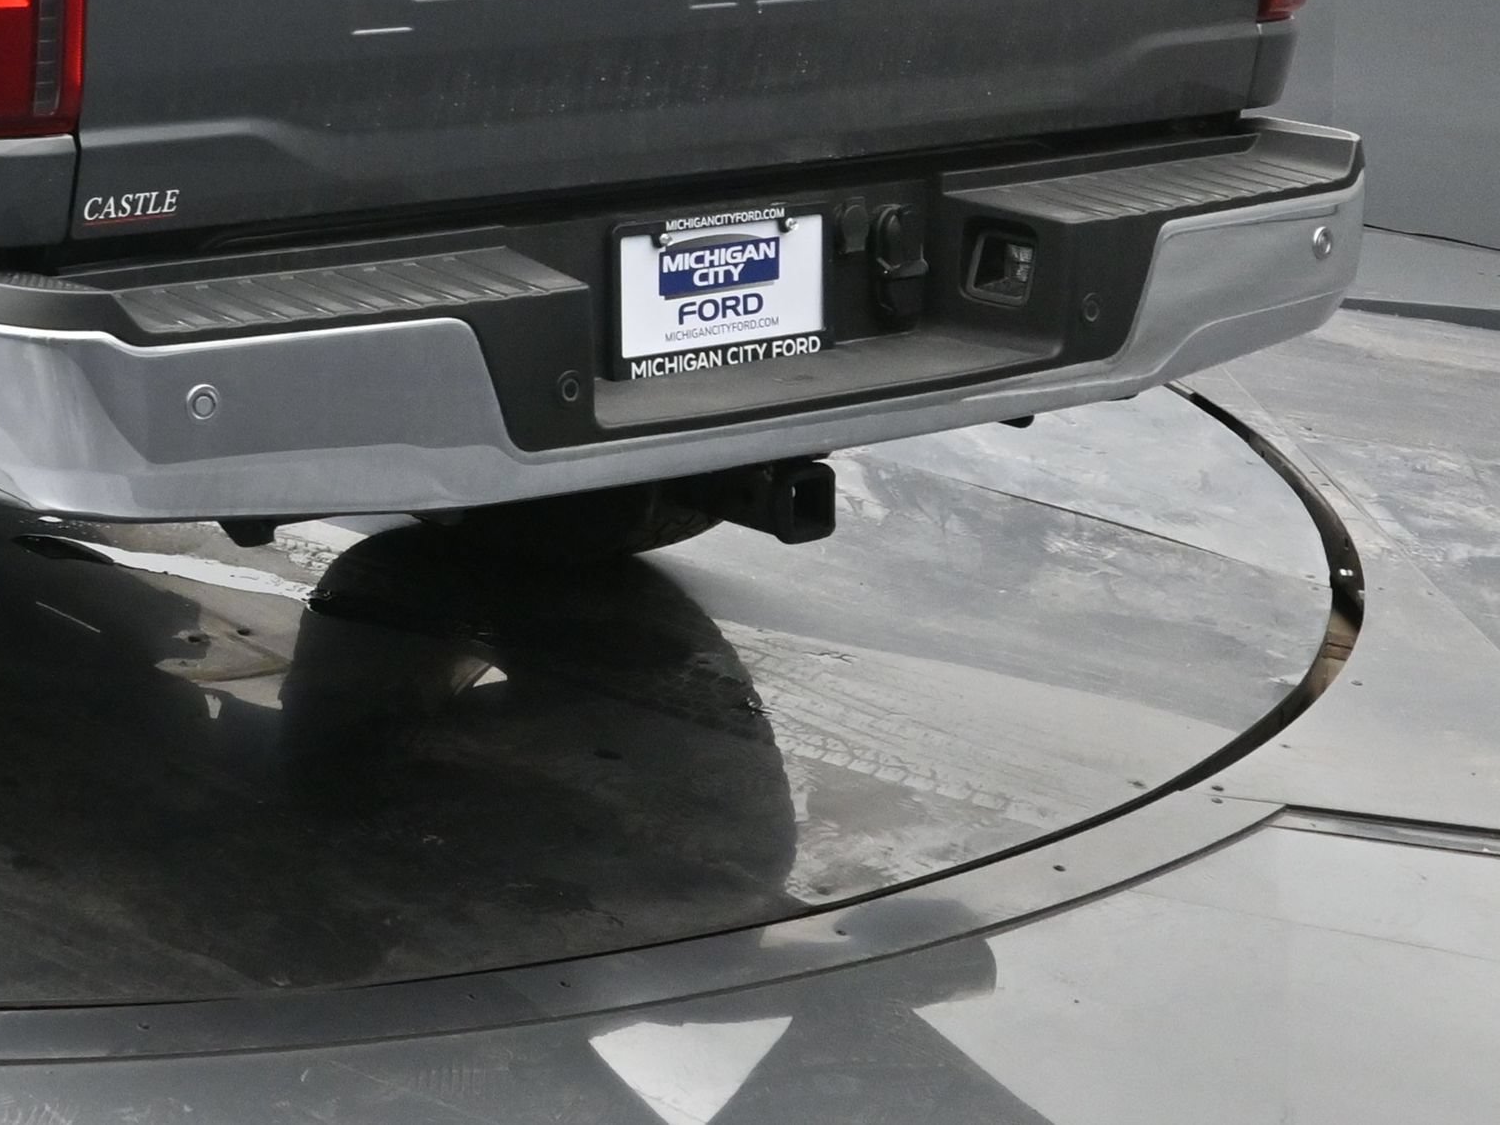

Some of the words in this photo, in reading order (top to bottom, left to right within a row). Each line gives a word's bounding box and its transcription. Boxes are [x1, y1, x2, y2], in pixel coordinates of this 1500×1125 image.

[83, 189, 180, 221] CASTLE
[665, 207, 785, 232] MICHIGANCITYFORD.COM
[662, 240, 776, 273] MICHIGAN
[692, 263, 746, 287] CITY
[678, 293, 764, 325] FORD
[664, 316, 780, 342] MICHIGANCITYFORD.COM
[630, 349, 723, 380] MICHIGAN
[726, 342, 768, 366] CITY
[772, 335, 821, 359] FORD
